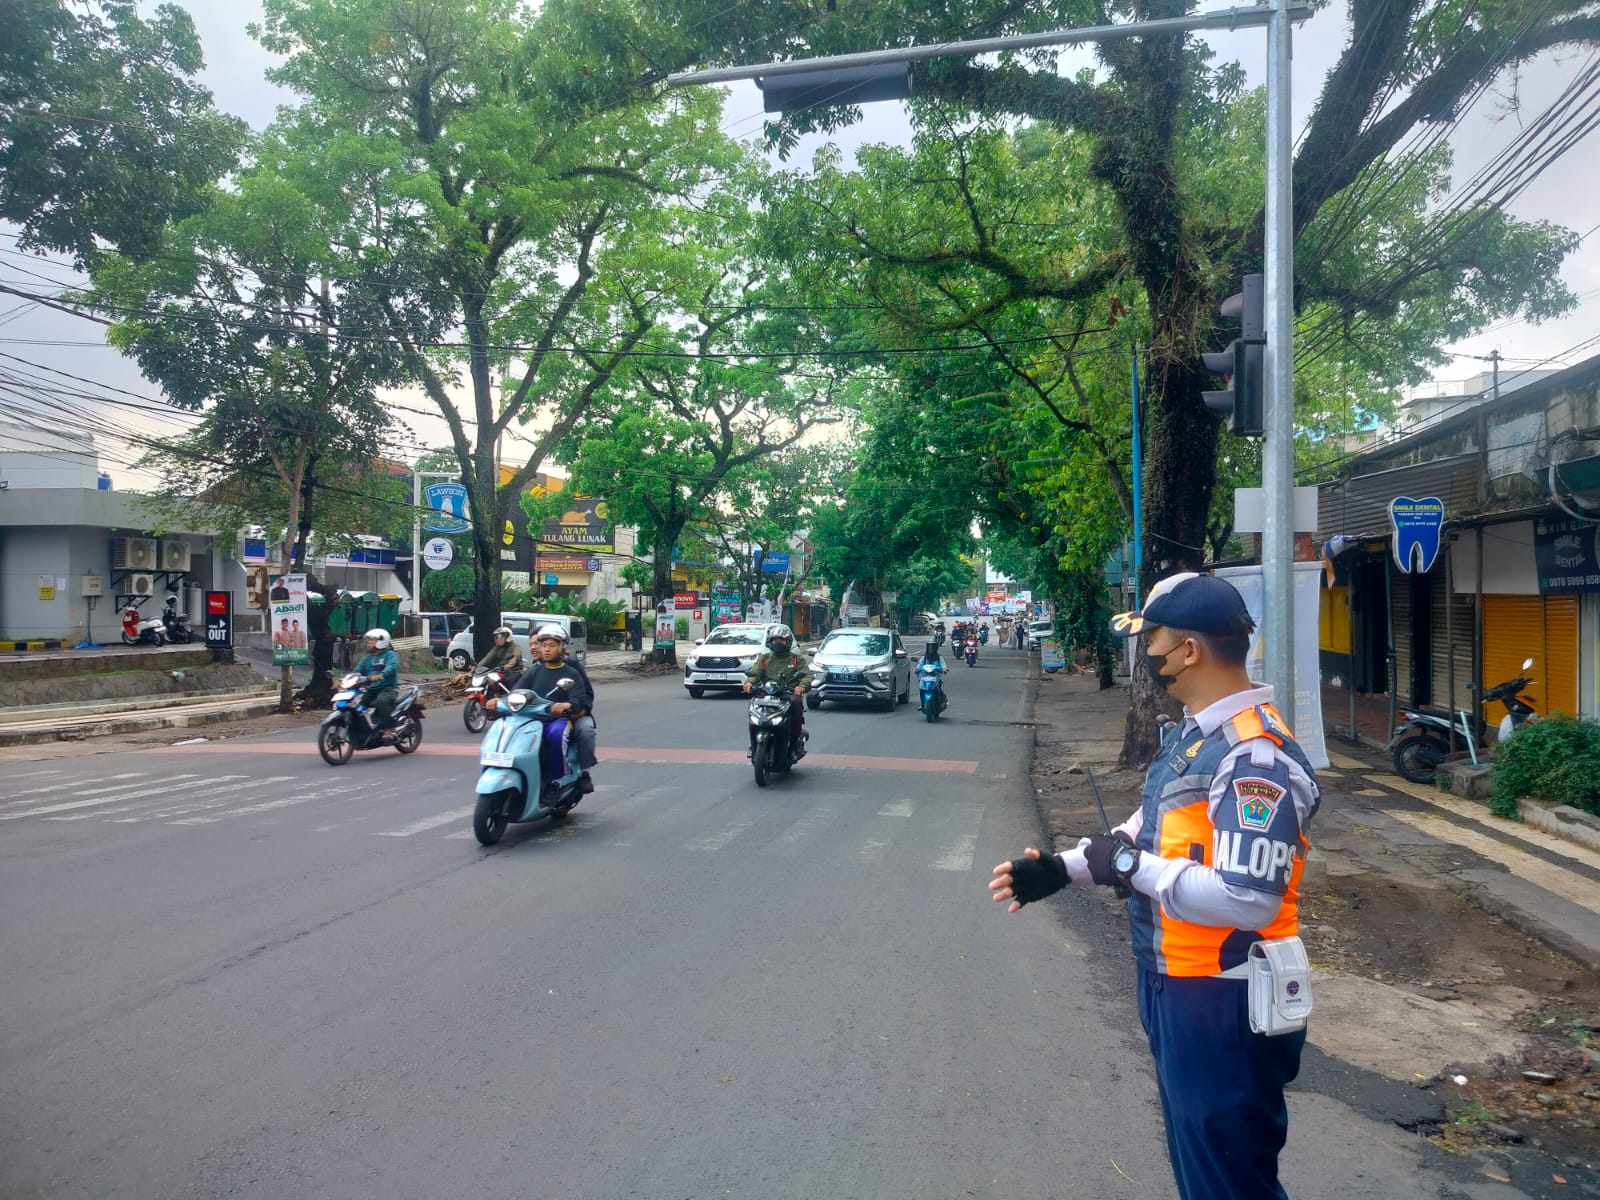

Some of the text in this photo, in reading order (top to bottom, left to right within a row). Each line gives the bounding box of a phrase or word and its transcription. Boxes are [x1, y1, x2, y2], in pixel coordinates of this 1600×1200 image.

[561, 527, 587, 535] AYAM
[543, 534, 607, 543] TULANG LUNAK
[1554, 534, 1581, 550] SMILE
[1555, 553, 1586, 569] DENTAL
[694, 611, 701, 619] P
[208, 629, 227, 641] OUT
